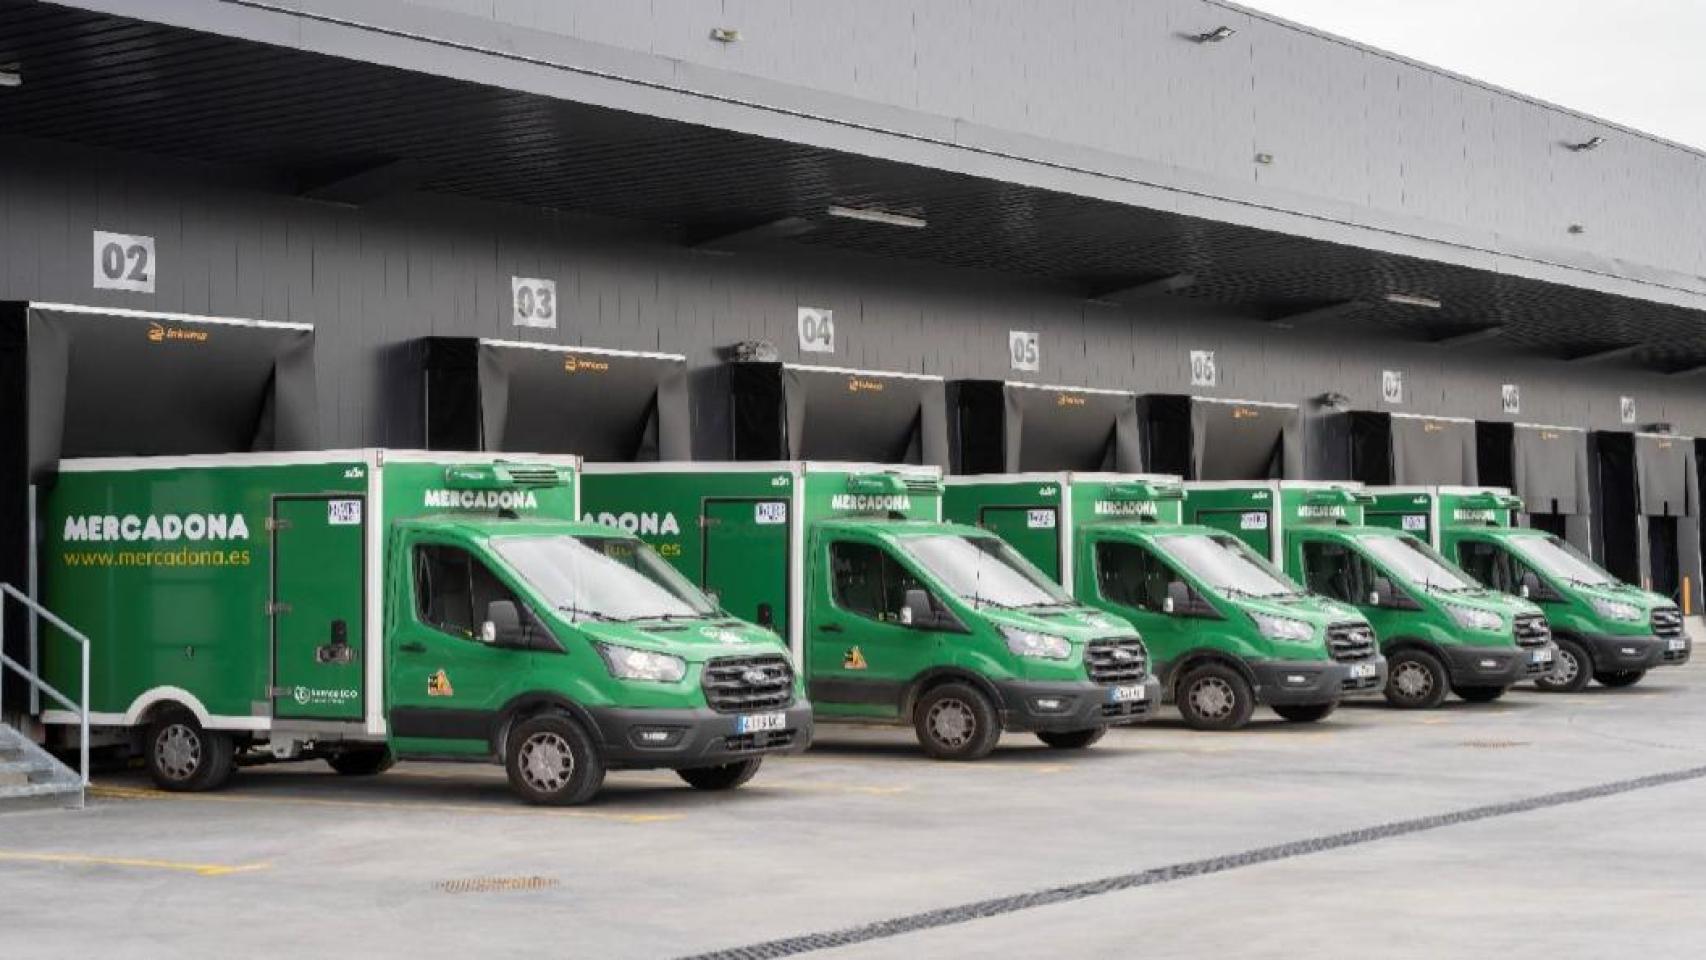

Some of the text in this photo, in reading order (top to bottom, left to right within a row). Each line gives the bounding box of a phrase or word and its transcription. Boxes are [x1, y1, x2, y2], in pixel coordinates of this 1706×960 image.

[102, 242, 148, 282] 02
[518, 286, 552, 319] 03
[803, 315, 832, 345] 04
[1014, 337, 1036, 363] 05
[1195, 356, 1213, 380] 06
[423, 488, 538, 509] MERCADONA
[831, 494, 912, 510] MERCADONA
[63, 514, 250, 541] MERCADONA
[63, 546, 250, 566] www.mercadona.es
